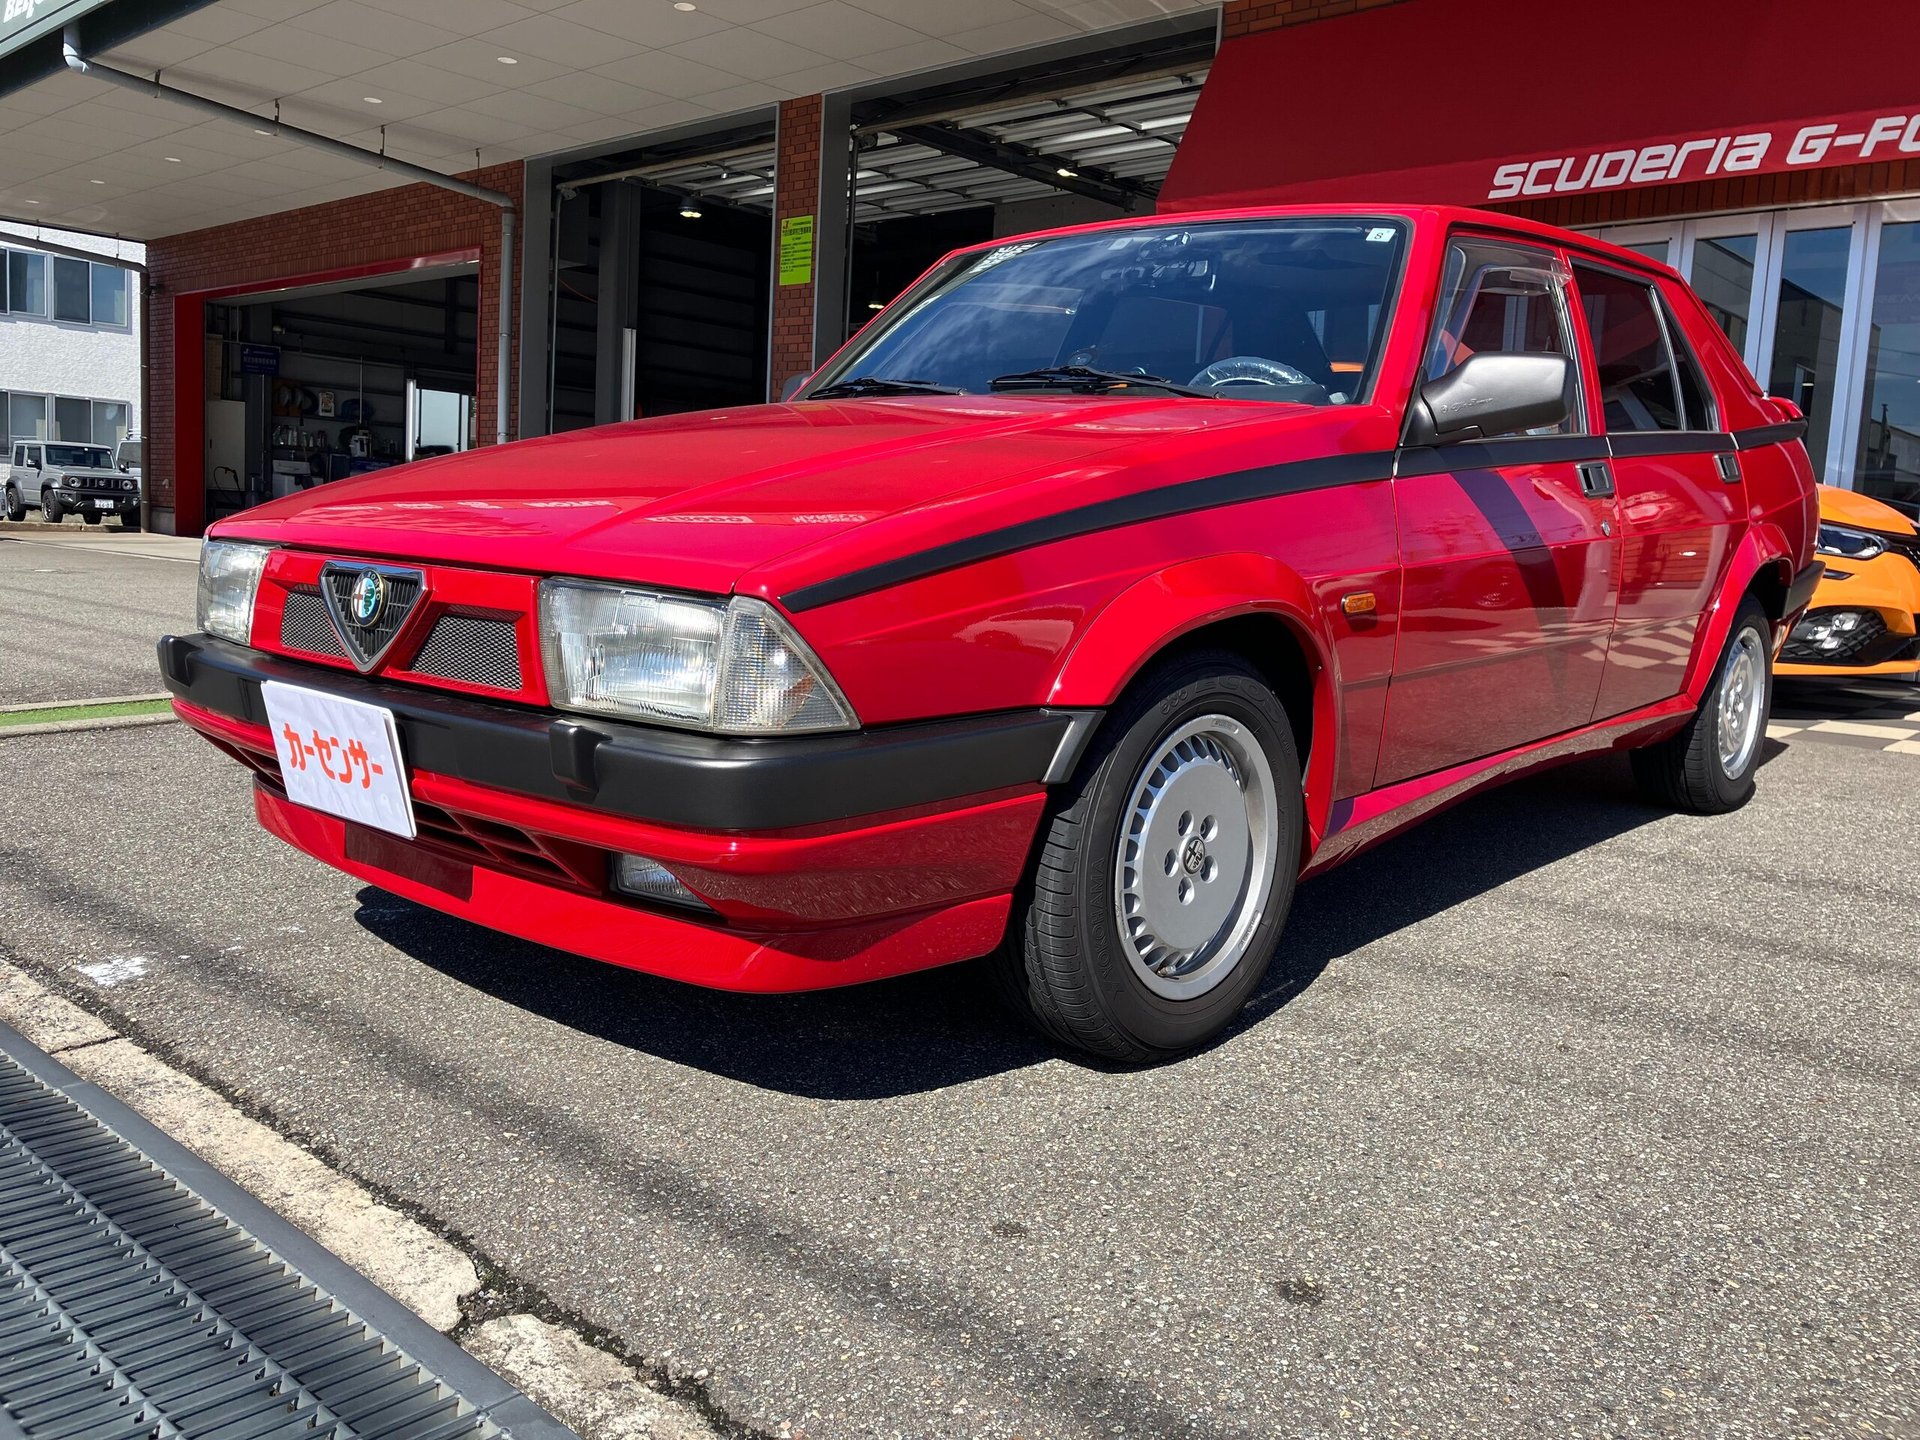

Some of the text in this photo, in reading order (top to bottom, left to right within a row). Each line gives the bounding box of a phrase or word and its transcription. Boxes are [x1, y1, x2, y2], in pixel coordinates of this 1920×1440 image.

[283, 723, 383, 789] カーセンサー
